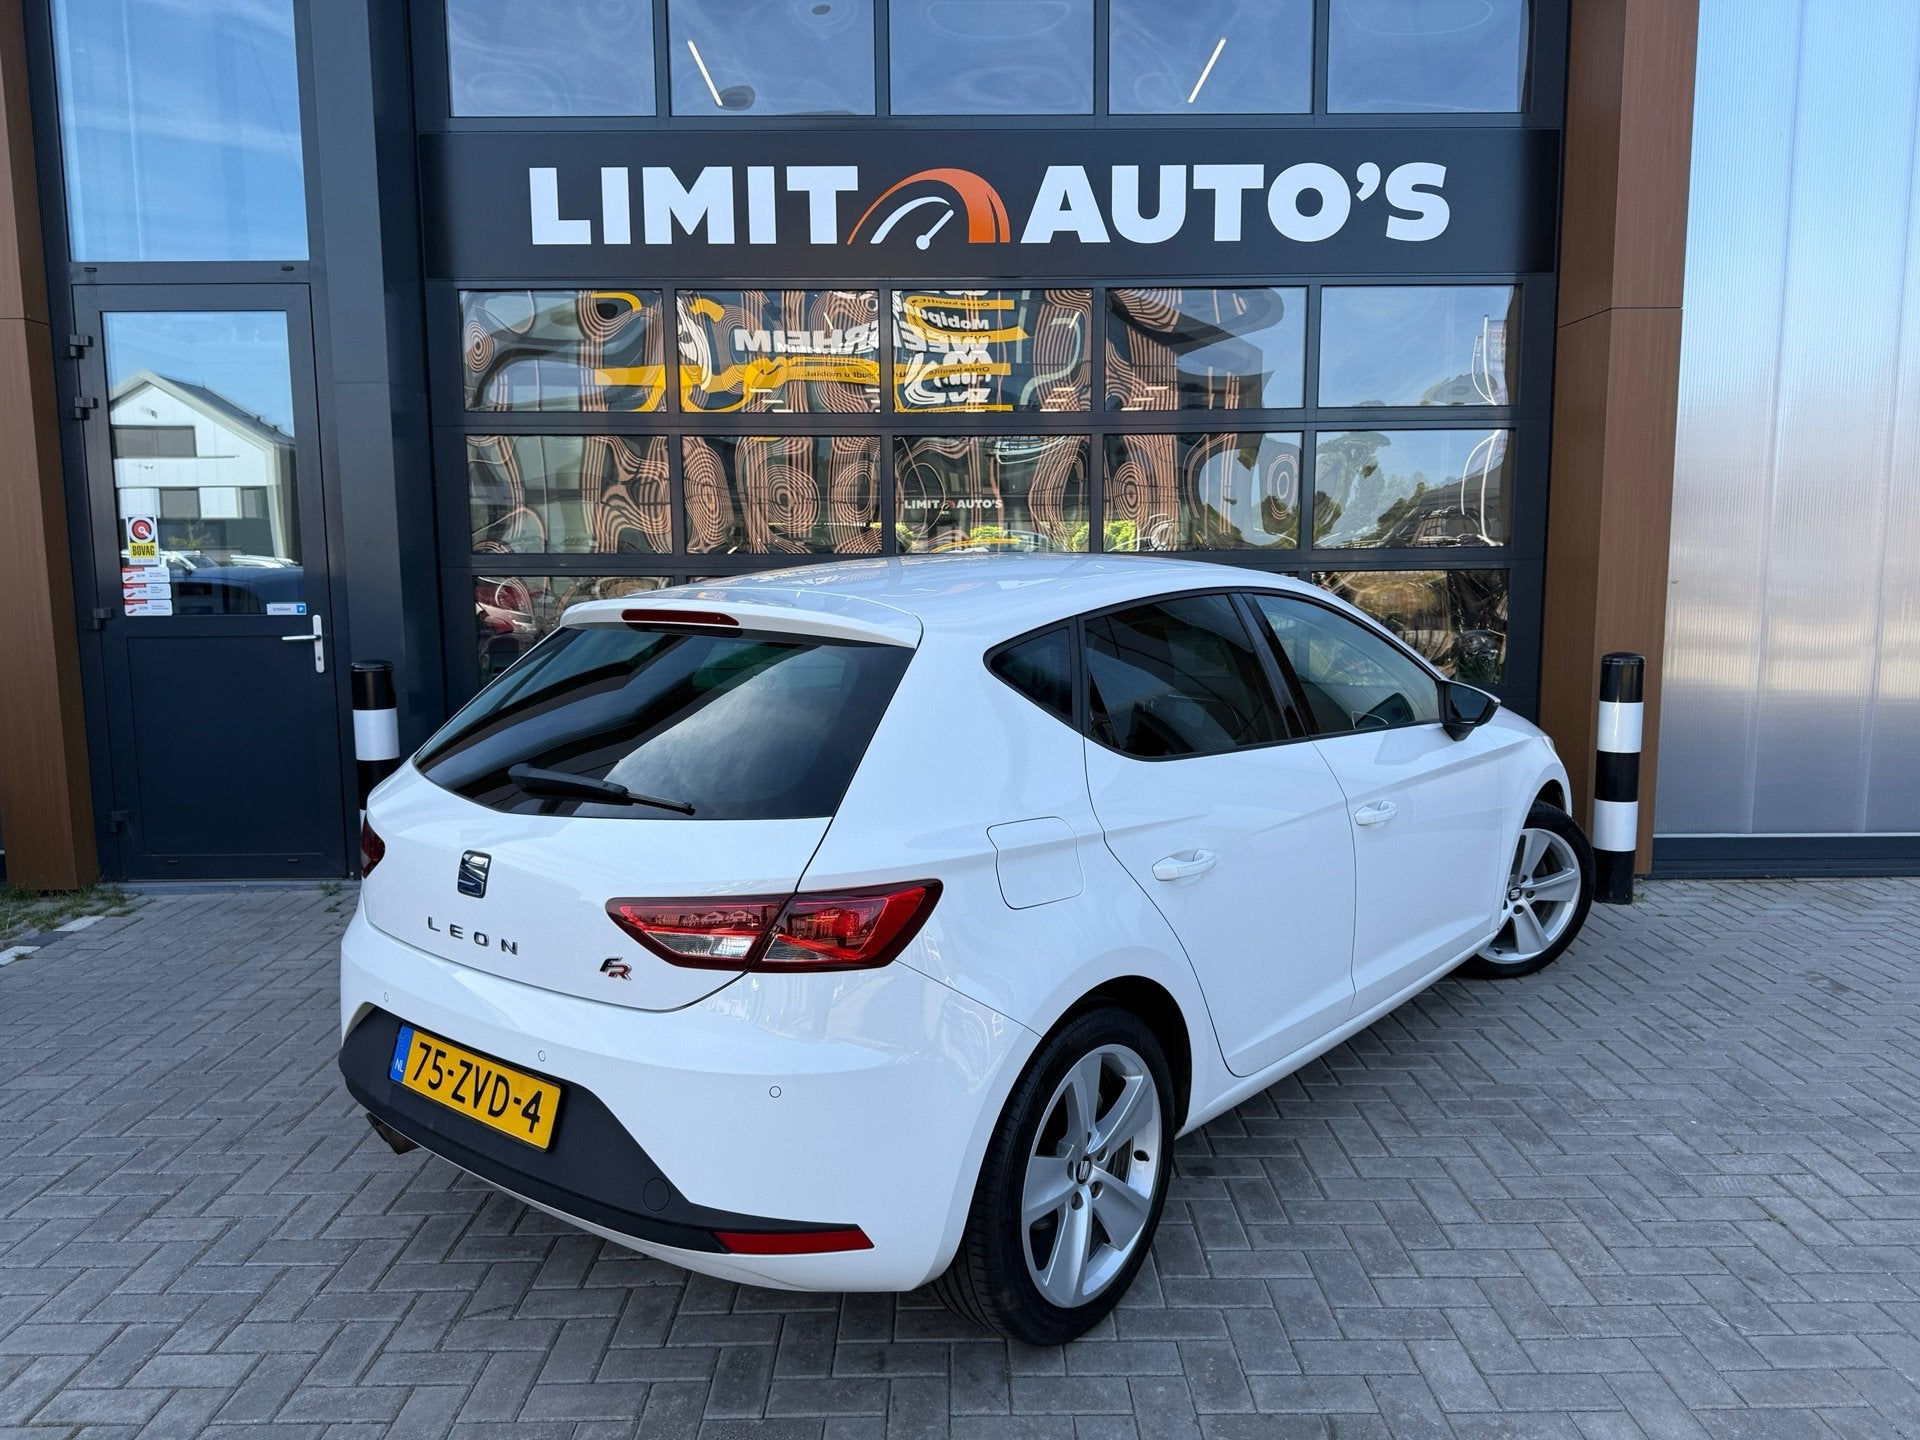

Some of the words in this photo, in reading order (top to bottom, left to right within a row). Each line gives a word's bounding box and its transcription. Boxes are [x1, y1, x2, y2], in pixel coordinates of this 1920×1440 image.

[529, 166, 858, 247] LIMIT
[1020, 161, 1451, 245] AUTO'S
[904, 500, 940, 509] LIMIT
[956, 500, 1004, 509] AUTO'S
[132, 545, 155, 556] BOVAG
[427, 916, 518, 955] LEON
[600, 956, 632, 981] FR
[394, 1058, 404, 1073] NL
[413, 1041, 543, 1134] 75-ZVD-4
